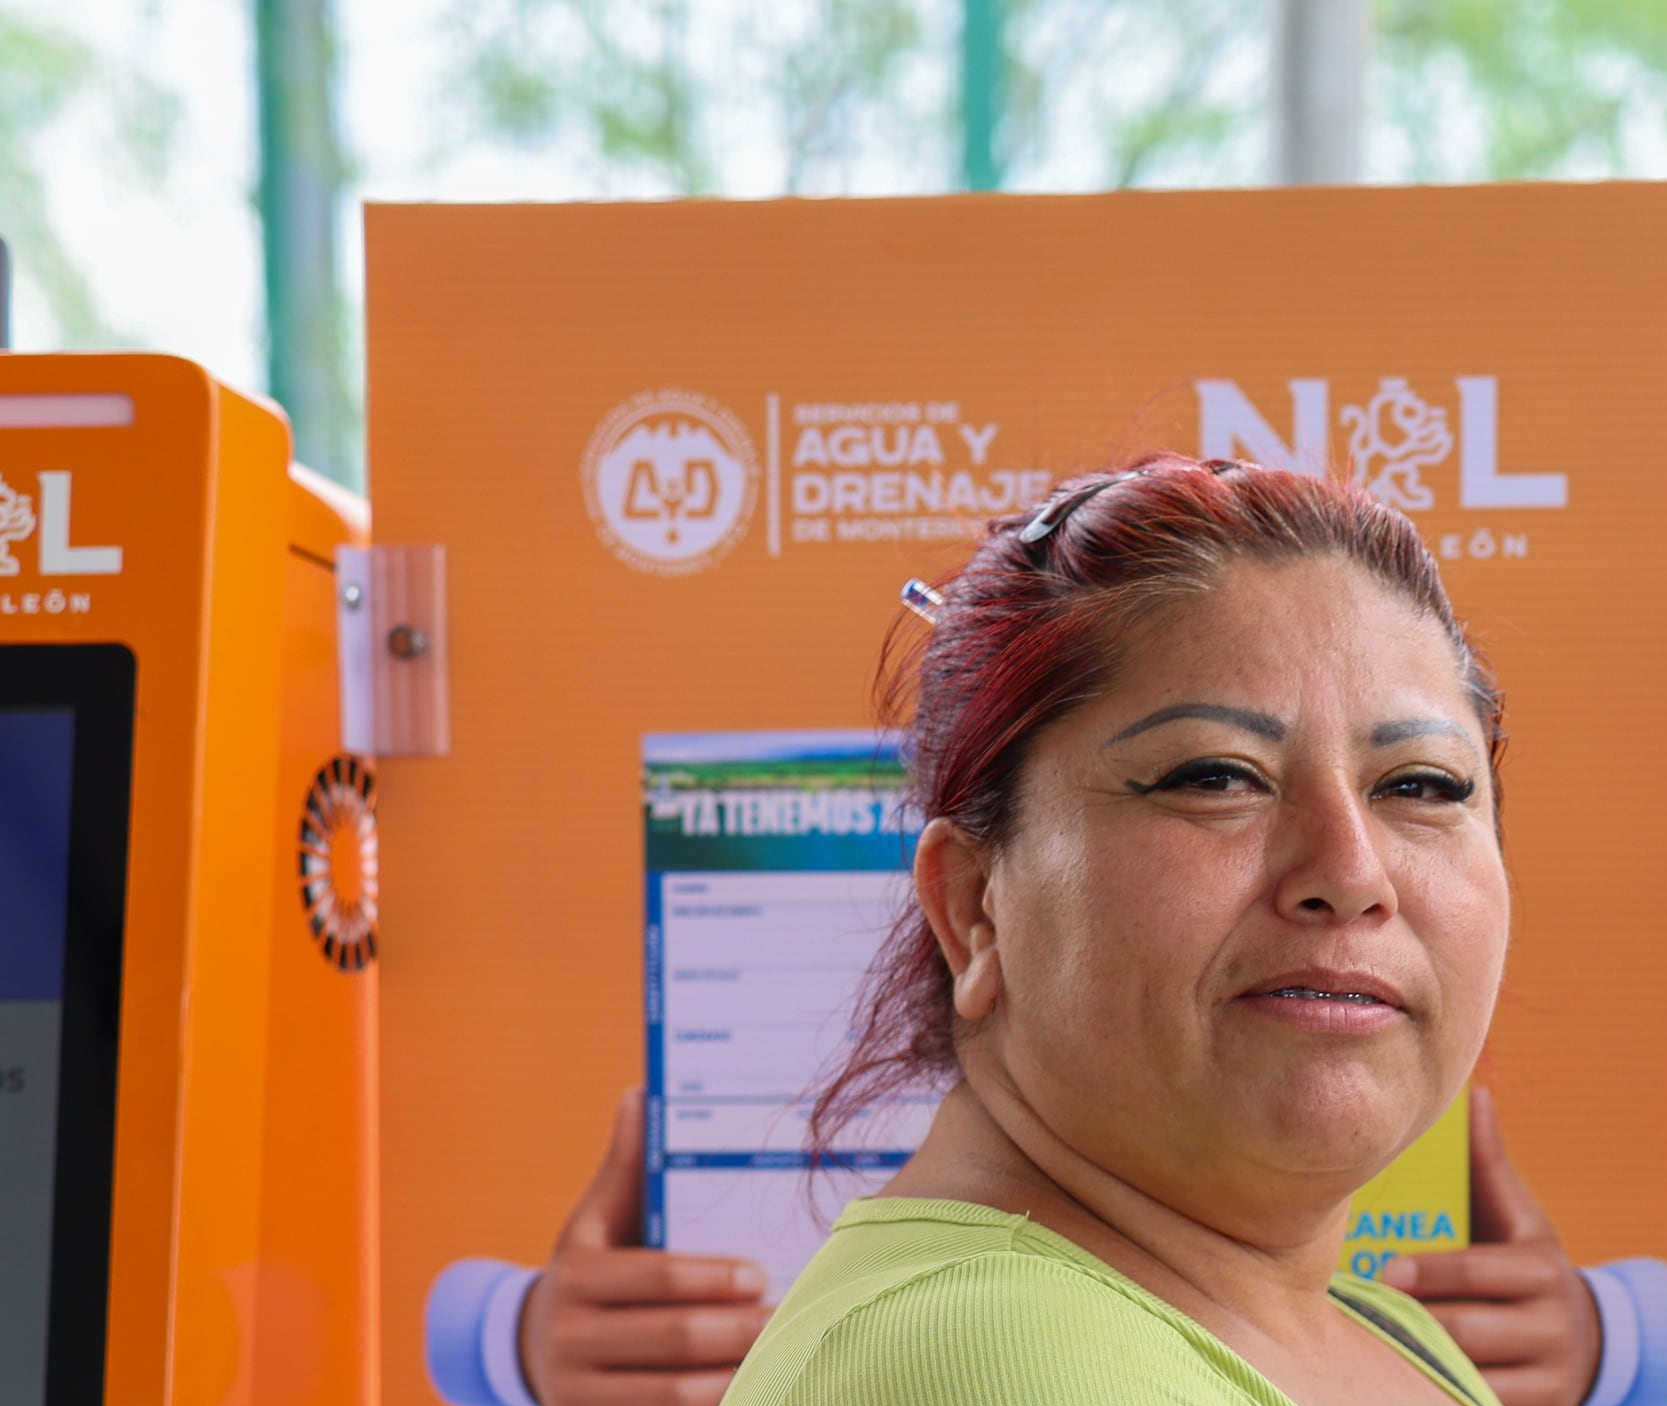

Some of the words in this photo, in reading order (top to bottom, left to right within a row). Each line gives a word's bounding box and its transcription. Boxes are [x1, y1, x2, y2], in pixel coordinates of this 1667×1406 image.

[926, 402, 960, 422] DE
[793, 425, 944, 466] AGUA
[959, 423, 998, 464] Y
[793, 471, 1053, 513] DRENAJE
[793, 519, 830, 541] DE
[1441, 530, 1528, 559] EÓN
[681, 789, 721, 835] YA
[722, 787, 876, 834] TENEMOS
[1347, 1211, 1456, 1241] ANEA
